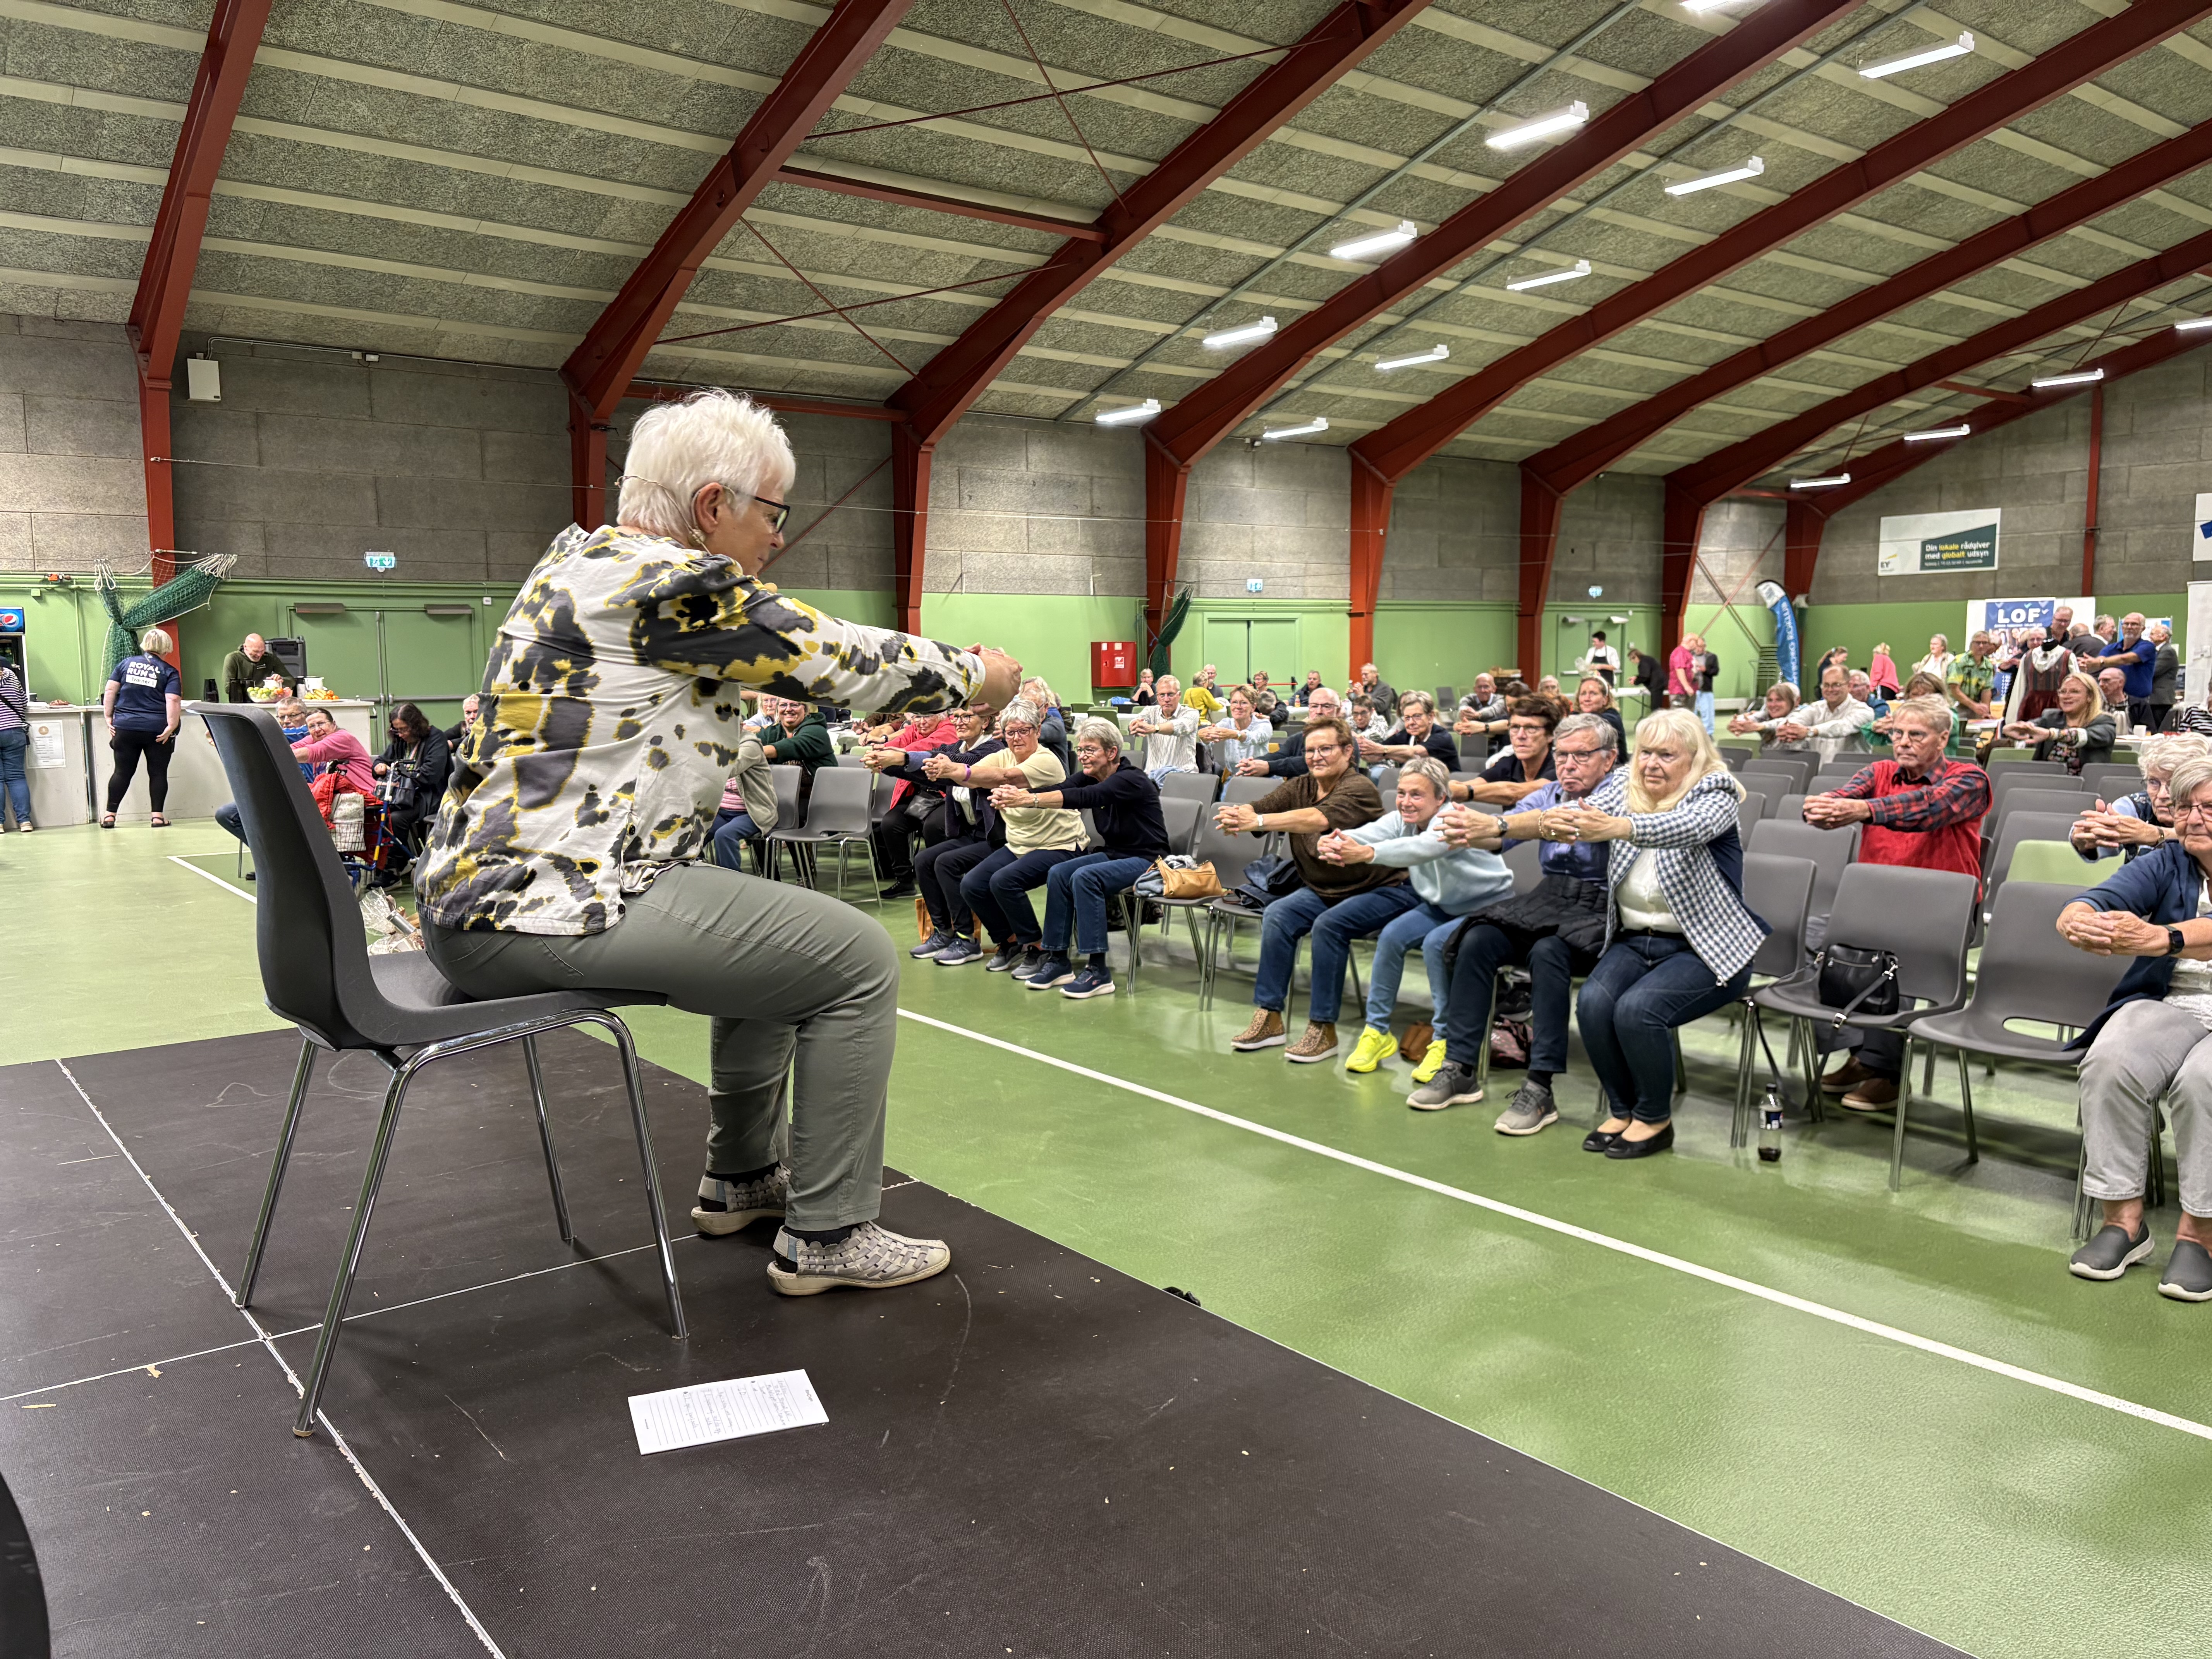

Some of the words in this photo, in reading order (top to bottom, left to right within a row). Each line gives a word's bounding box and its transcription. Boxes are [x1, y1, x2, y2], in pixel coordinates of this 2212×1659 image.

[1939, 543, 1960, 551] lokale
[1961, 541, 1990, 550] rådgiver
[1941, 550, 1966, 560] globalt
[1967, 550, 1989, 558] udsyn
[1997, 608, 2040, 623] LOF
[127, 667, 148, 677] RUN
[129, 661, 160, 673] ROYAL
